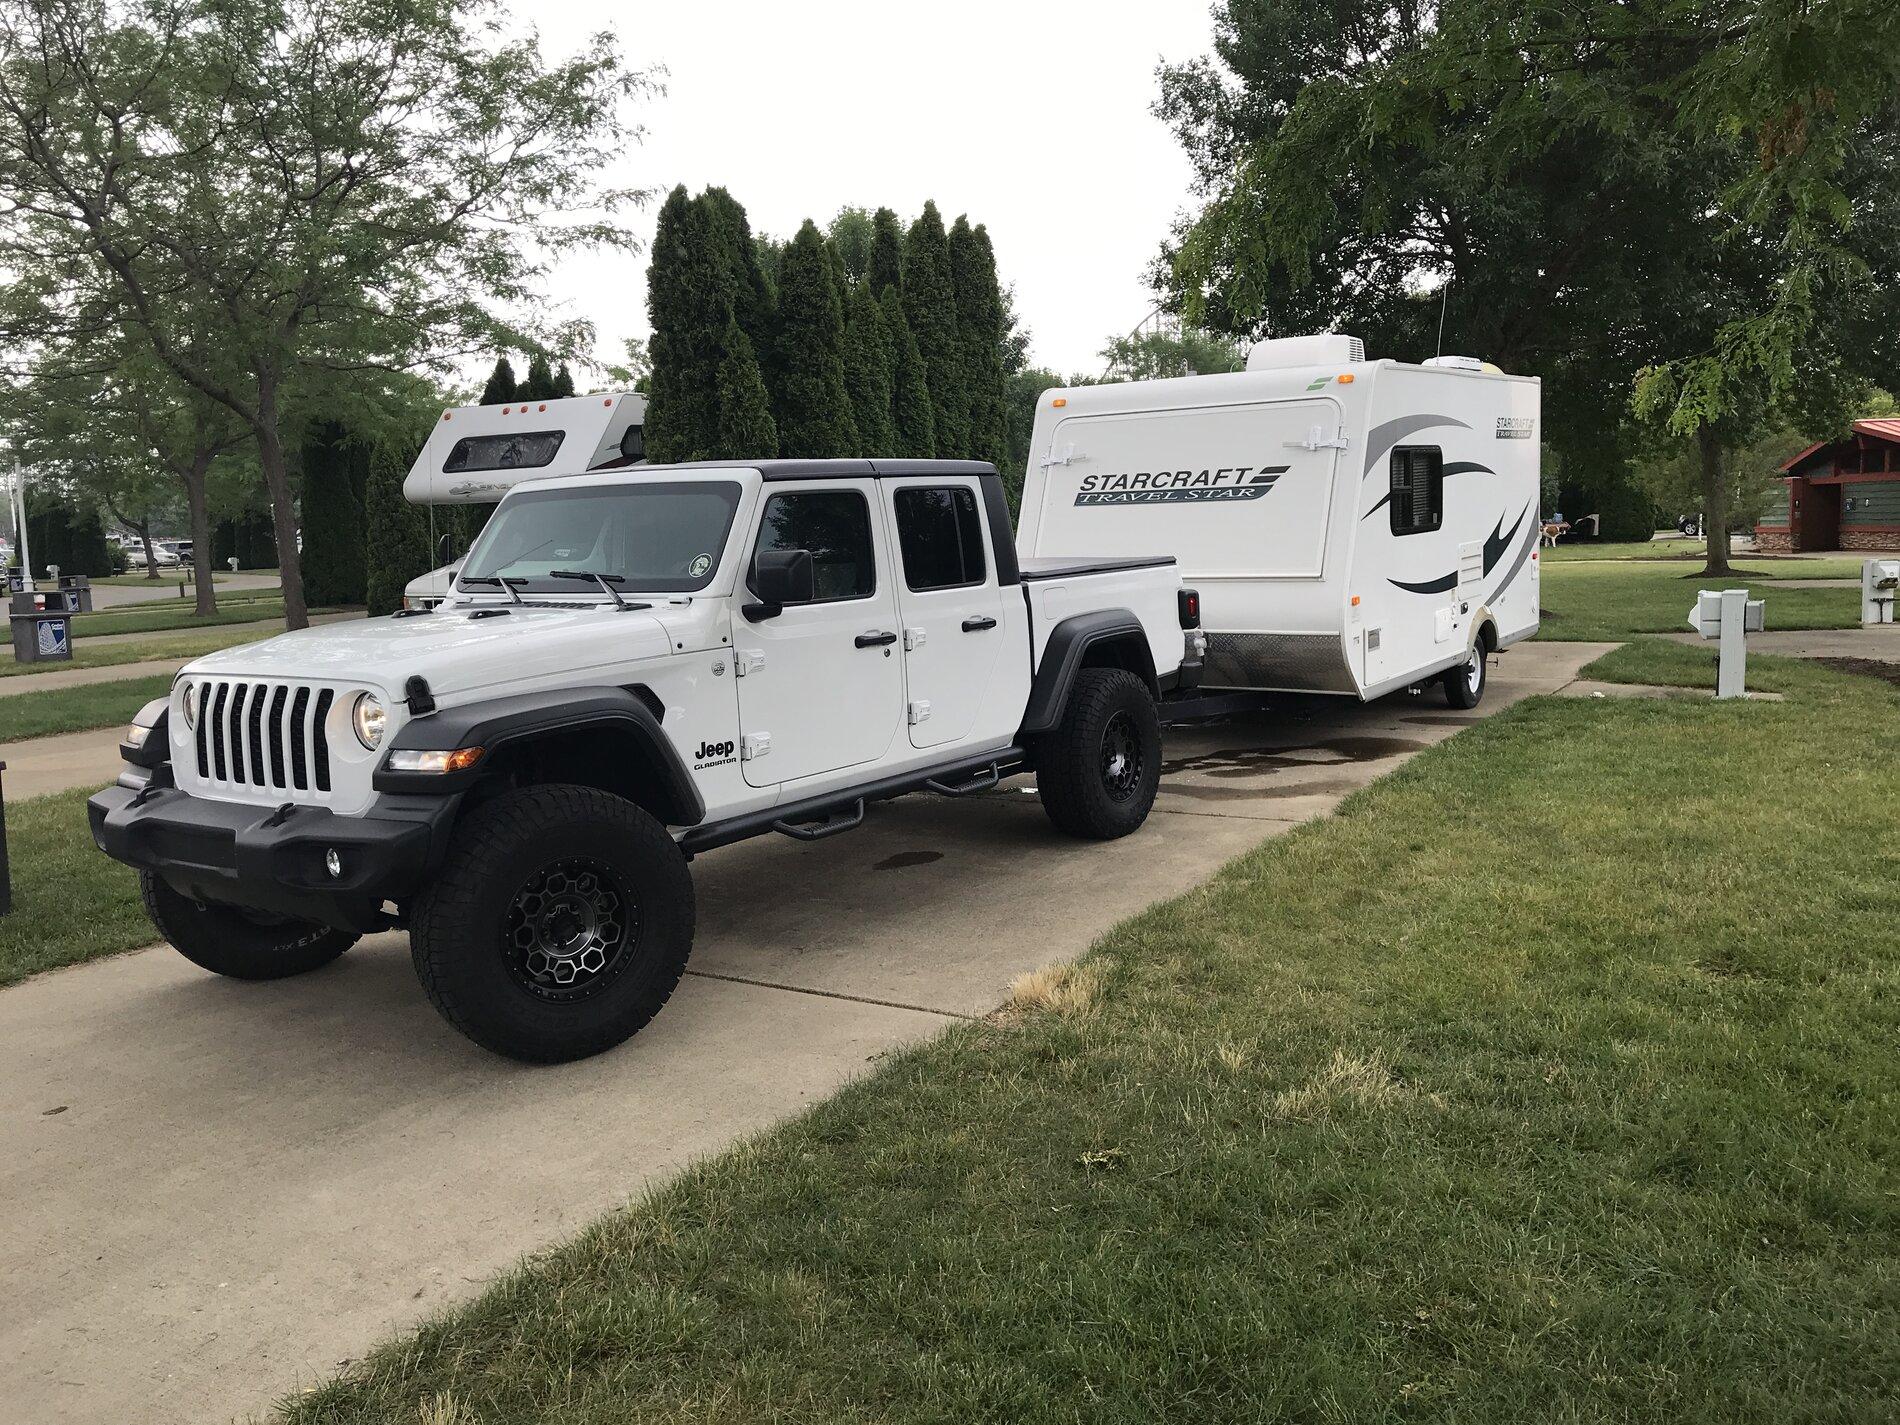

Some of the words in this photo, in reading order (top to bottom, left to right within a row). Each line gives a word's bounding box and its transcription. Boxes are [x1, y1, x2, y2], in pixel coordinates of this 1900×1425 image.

[1496, 417, 1530, 429] STARCRAFT
[1079, 467, 1253, 492] STARCRAFT
[1079, 490, 1178, 503] TRAVEL
[1184, 487, 1256, 499] STAR
[694, 740, 735, 760] Jeep
[693, 757, 737, 771] GLADIATOR
